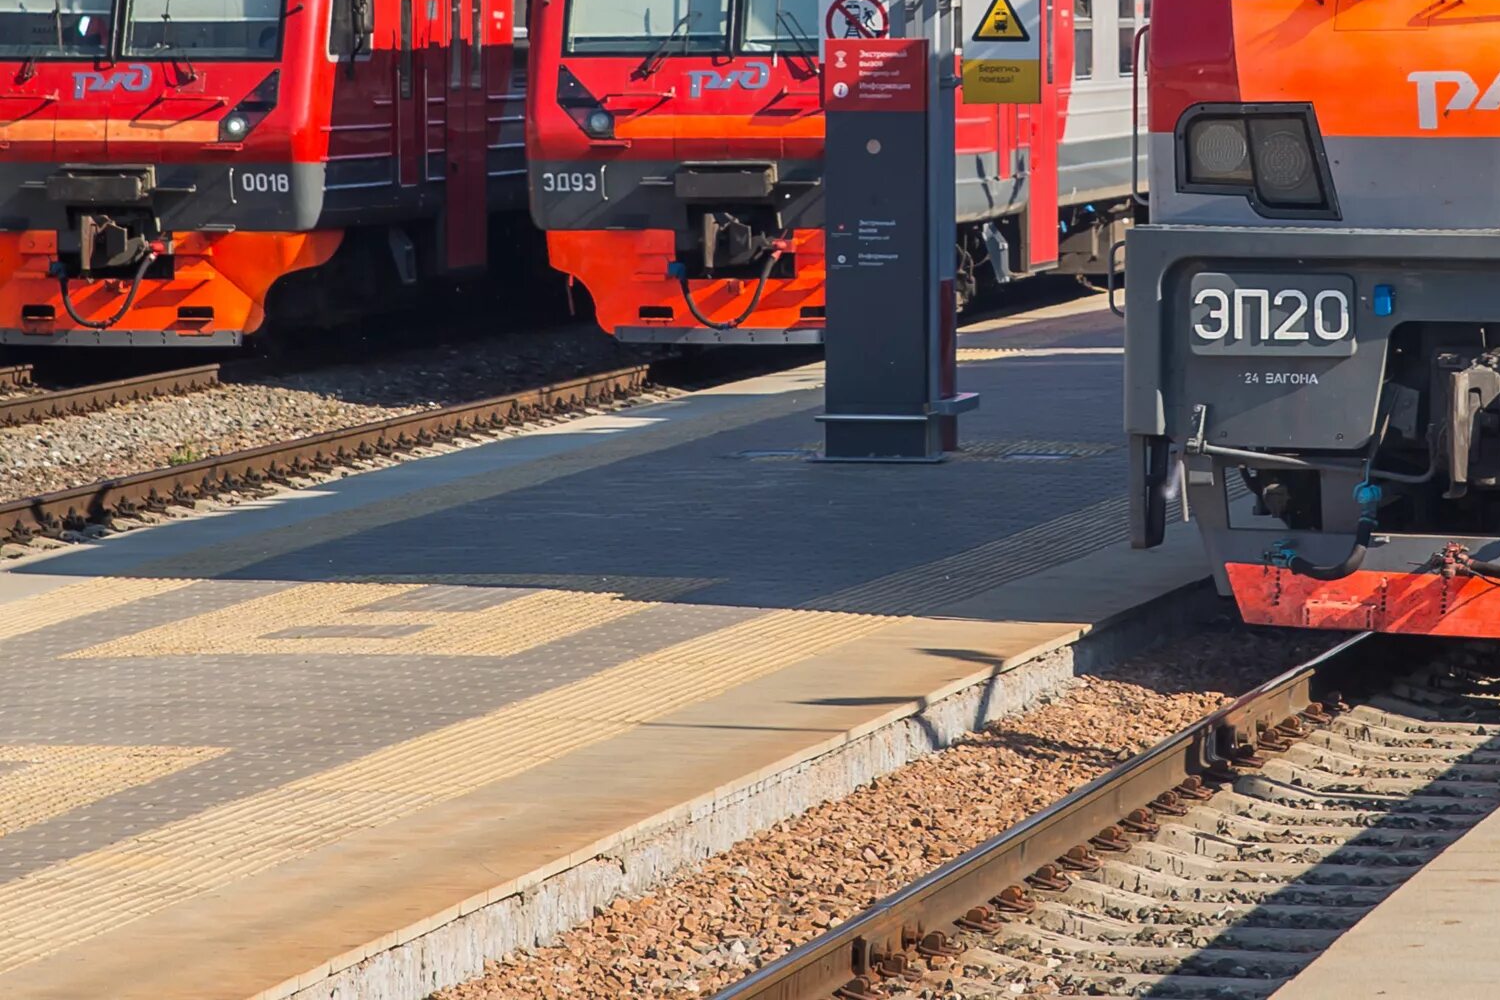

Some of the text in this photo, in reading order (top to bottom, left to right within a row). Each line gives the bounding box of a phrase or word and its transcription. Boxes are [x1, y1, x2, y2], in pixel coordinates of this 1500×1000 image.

[72, 64, 153, 100] РЖД
[687, 61, 770, 98] РЖД
[242, 173, 289, 192] 0018
[542, 172, 596, 192] ЭД93
[1194, 288, 1350, 341] ЭП20
[1244, 372, 1319, 385] 24 ВАГОНА
